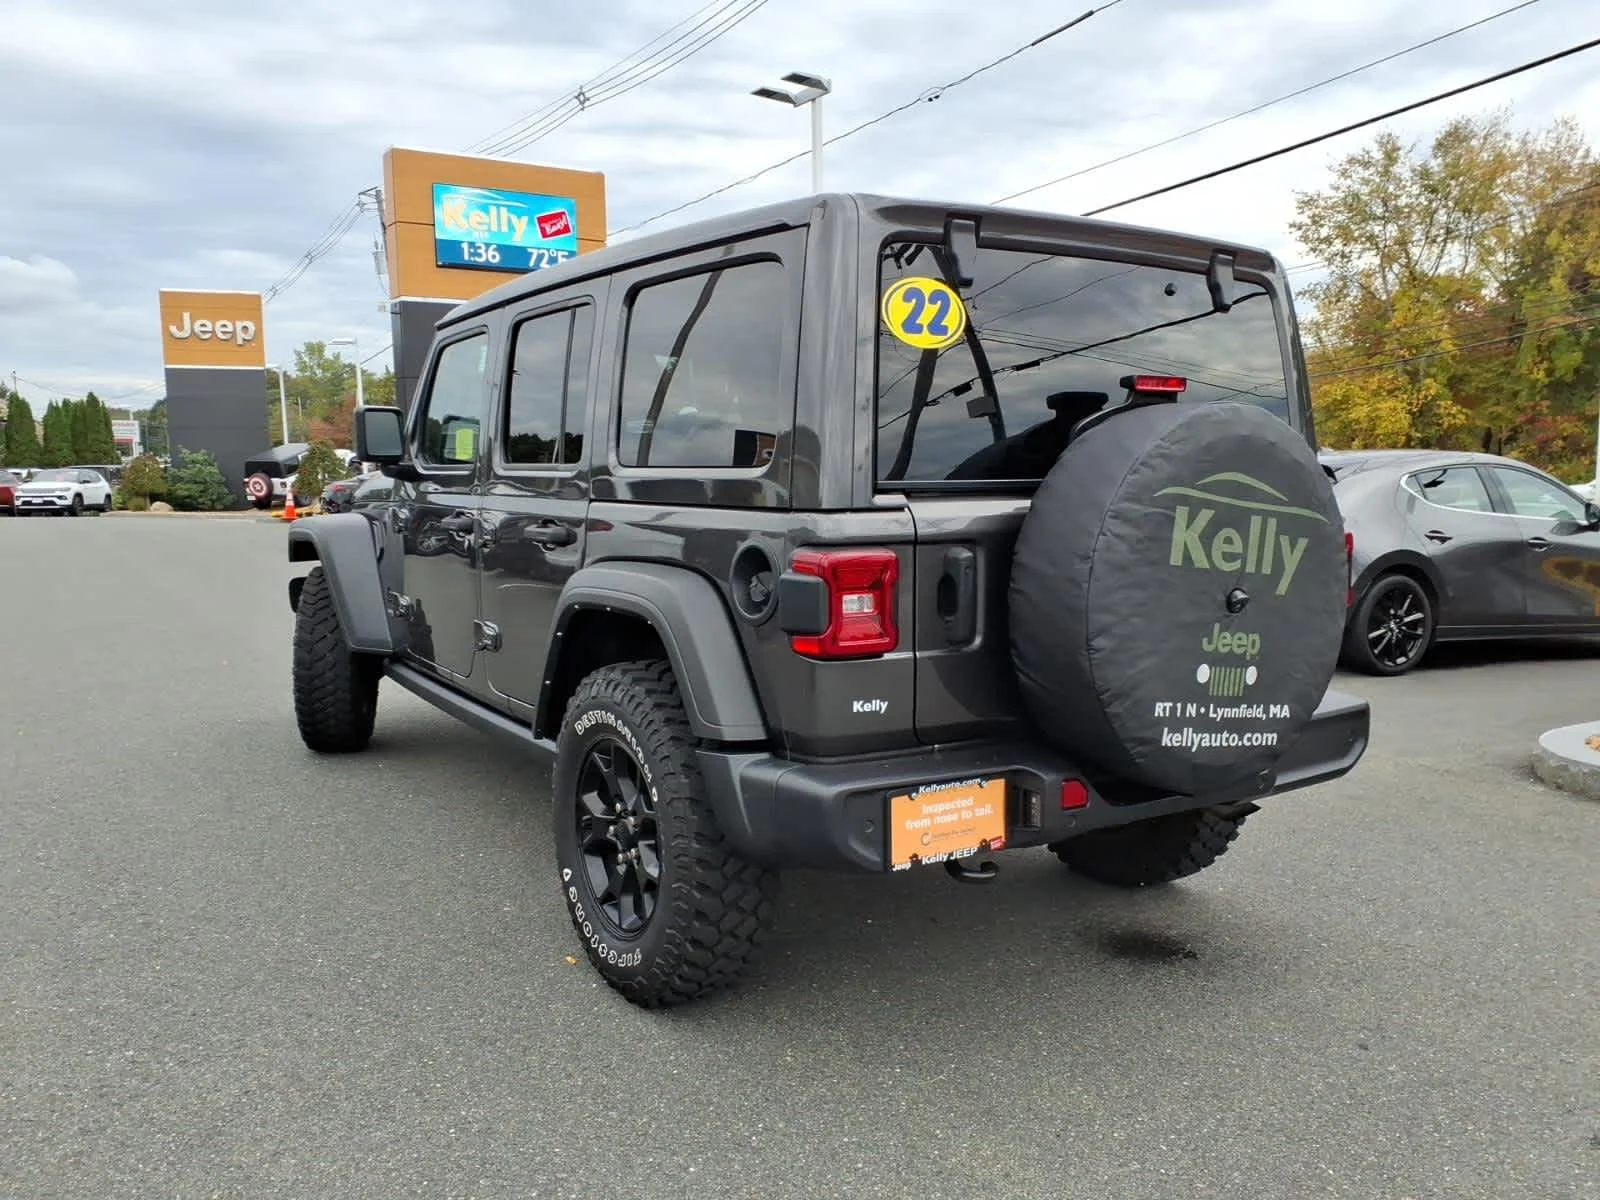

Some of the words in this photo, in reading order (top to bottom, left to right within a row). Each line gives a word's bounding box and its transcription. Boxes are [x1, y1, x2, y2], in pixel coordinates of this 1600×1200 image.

[442, 198, 528, 241] Kelly
[461, 242, 500, 263] 1:36
[901, 287, 951, 336] 22
[168, 311, 256, 345] Jeep
[1169, 505, 1309, 596] Kelly
[1202, 622, 1260, 660] Jeep
[852, 699, 889, 714] Kelly
[1154, 702, 1173, 717] RT
[1176, 702, 1182, 717] 1
[1186, 703, 1197, 717] N
[1209, 703, 1266, 721] Lynnfield,
[1269, 704, 1291, 718] MA
[1161, 727, 1278, 752] kellyauto.com
[905, 817, 931, 831] from
[961, 808, 973, 820] to
[922, 851, 949, 866] Kelly
[949, 846, 979, 860] JEEP
